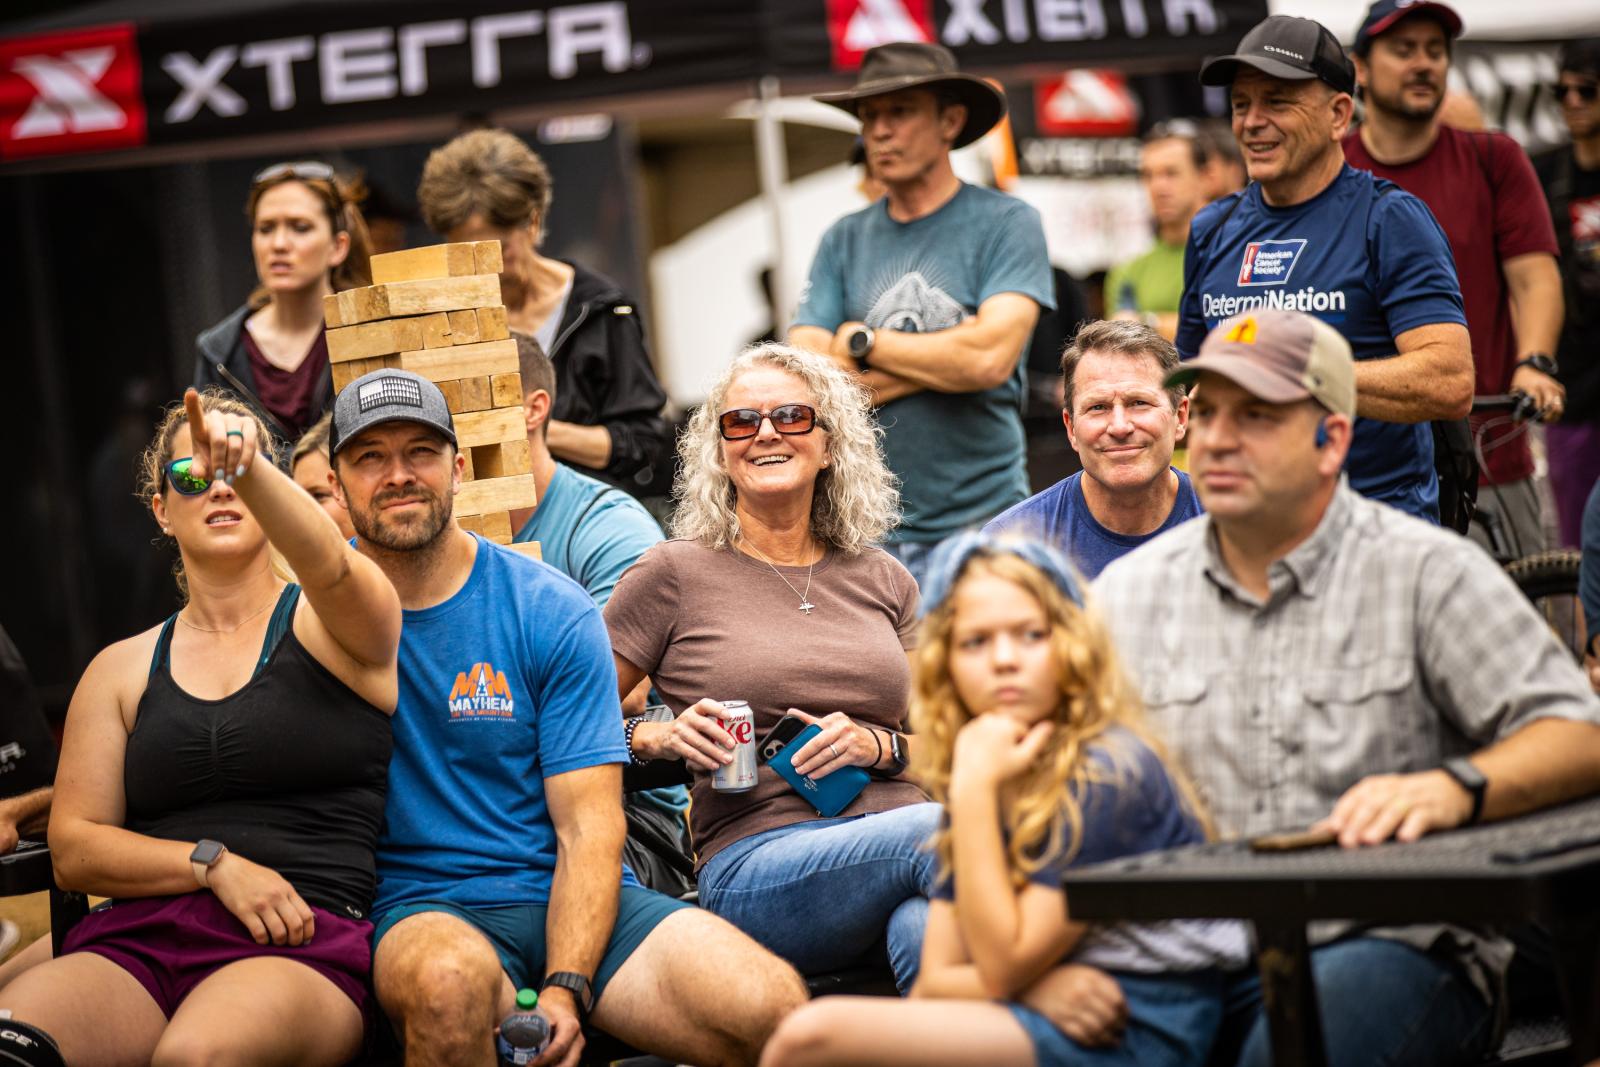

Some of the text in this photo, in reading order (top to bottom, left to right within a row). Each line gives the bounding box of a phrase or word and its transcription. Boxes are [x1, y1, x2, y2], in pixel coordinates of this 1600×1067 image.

[161, 1, 637, 124] XTERRA
[1202, 286, 1346, 317] DetermiNation
[448, 697, 514, 712] MAYHEM
